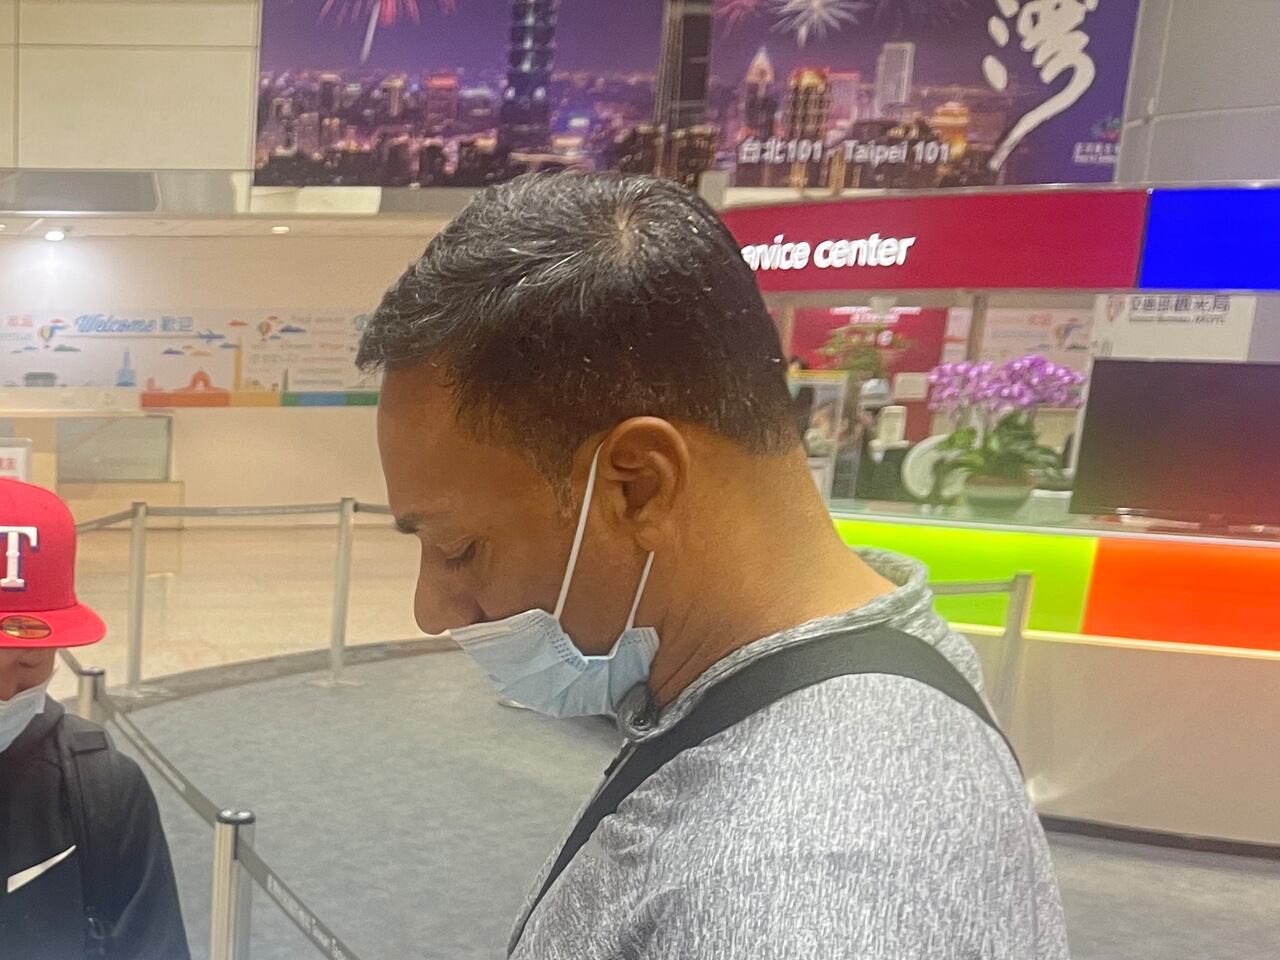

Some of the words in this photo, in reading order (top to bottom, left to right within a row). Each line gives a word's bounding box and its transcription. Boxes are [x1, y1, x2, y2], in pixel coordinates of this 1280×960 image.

[844, 138, 909, 168] Taipei
[911, 139, 950, 165] 101
[814, 232, 917, 269] center
[74, 312, 157, 333] Welcome
